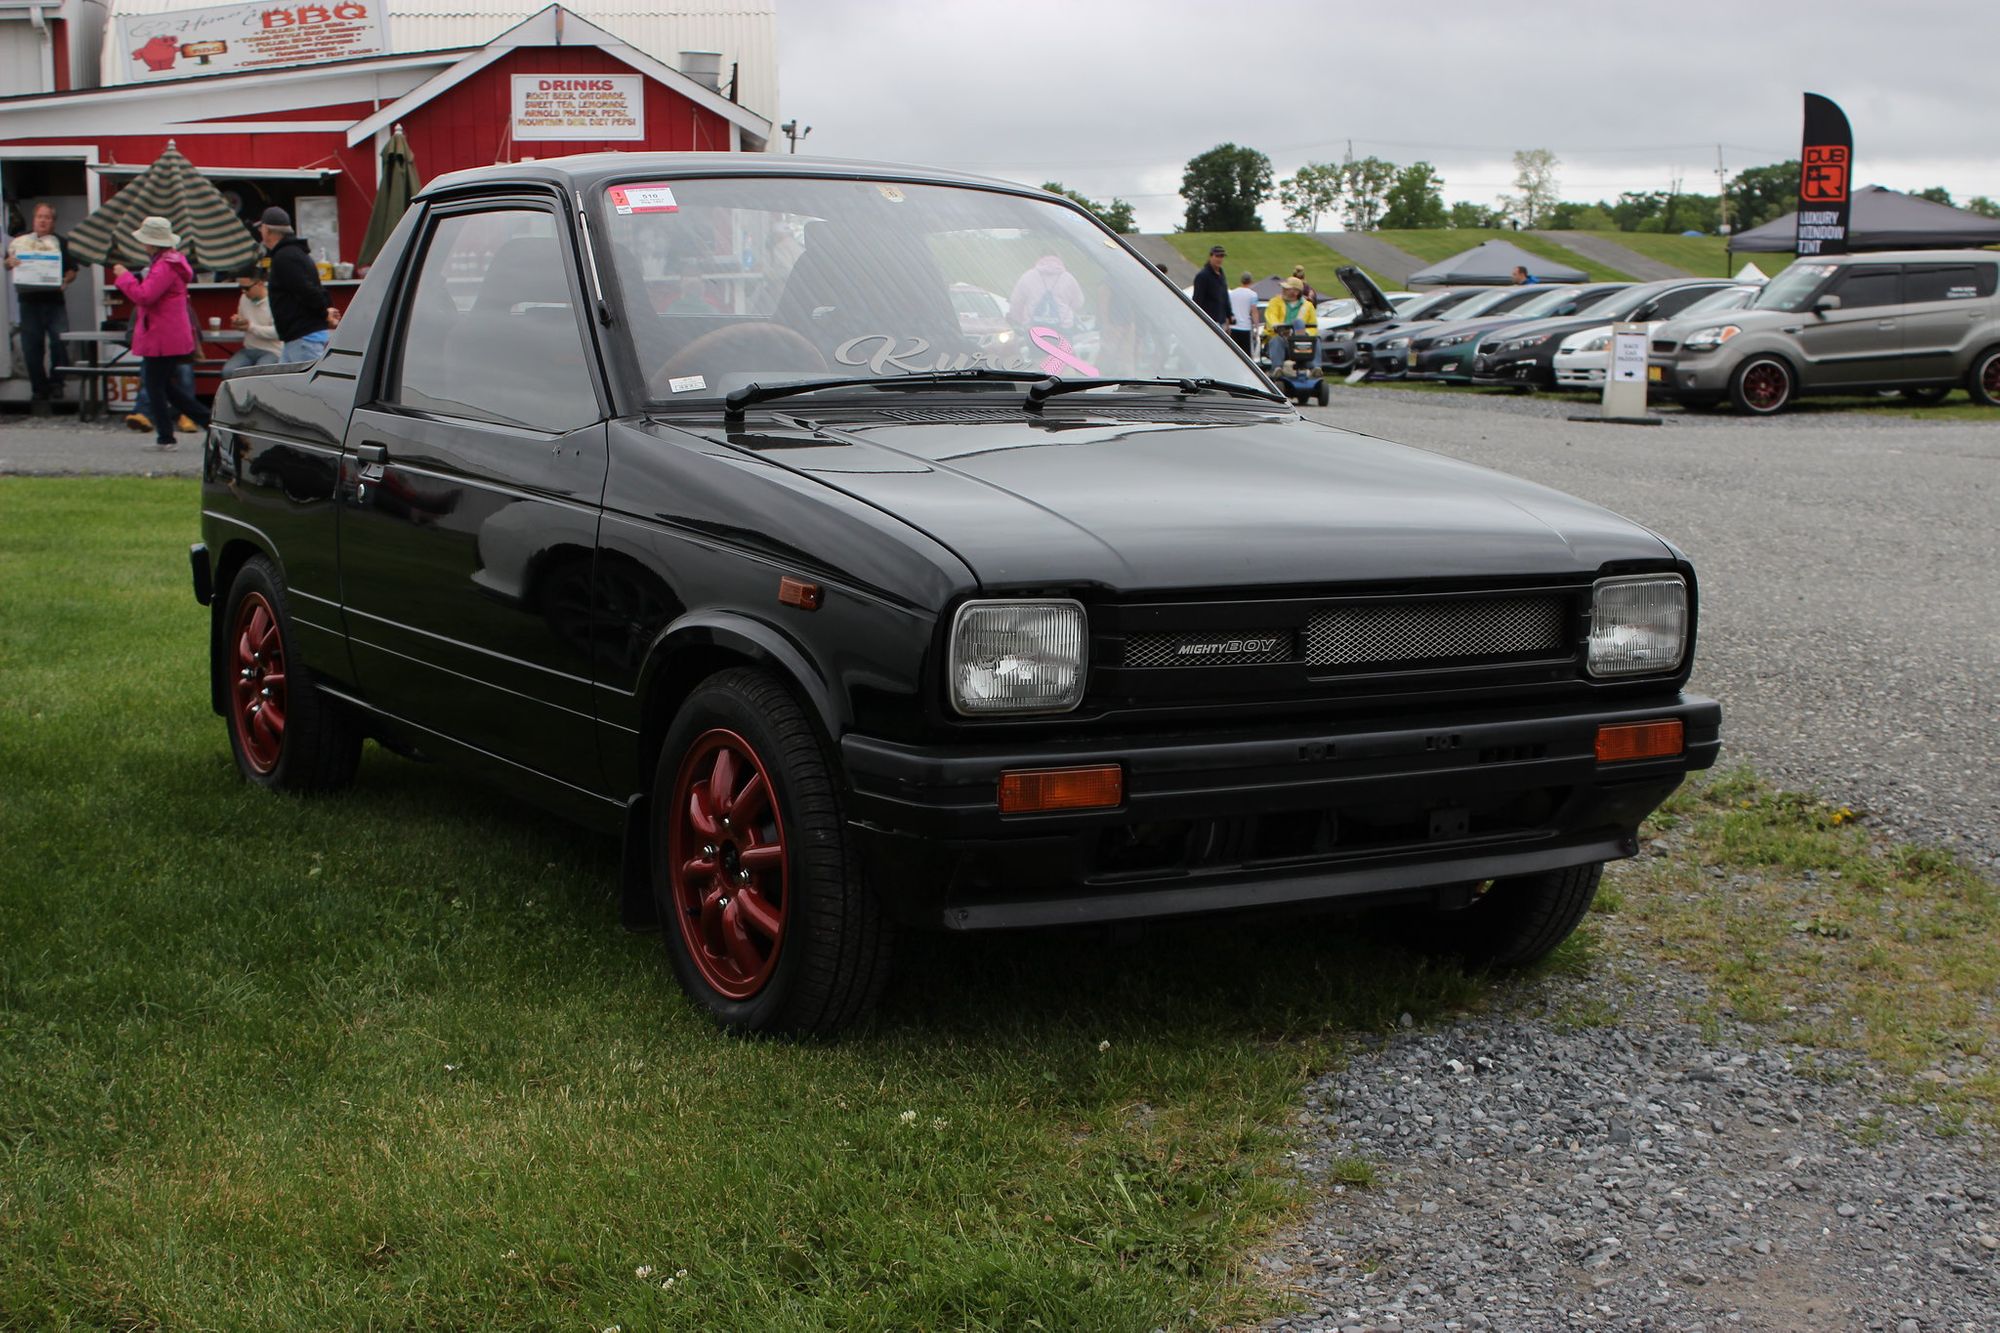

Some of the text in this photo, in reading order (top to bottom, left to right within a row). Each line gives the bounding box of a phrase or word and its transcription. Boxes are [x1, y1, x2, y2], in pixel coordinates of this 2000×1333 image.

[261, 1, 369, 29] BBQ
[538, 79, 615, 91] DRINKS
[526, 92, 550, 100] ROOT
[525, 101, 554, 109] SWEET
[525, 110, 561, 118] ARNOLD
[518, 118, 565, 126] MOUNTAIN
[611, 118, 637, 126] PEPSI
[1806, 149, 1845, 164] DUB
[1799, 211, 1840, 225] LUXURY
[1798, 226, 1845, 240] WINDOW
[1797, 240, 1823, 254] TINT
